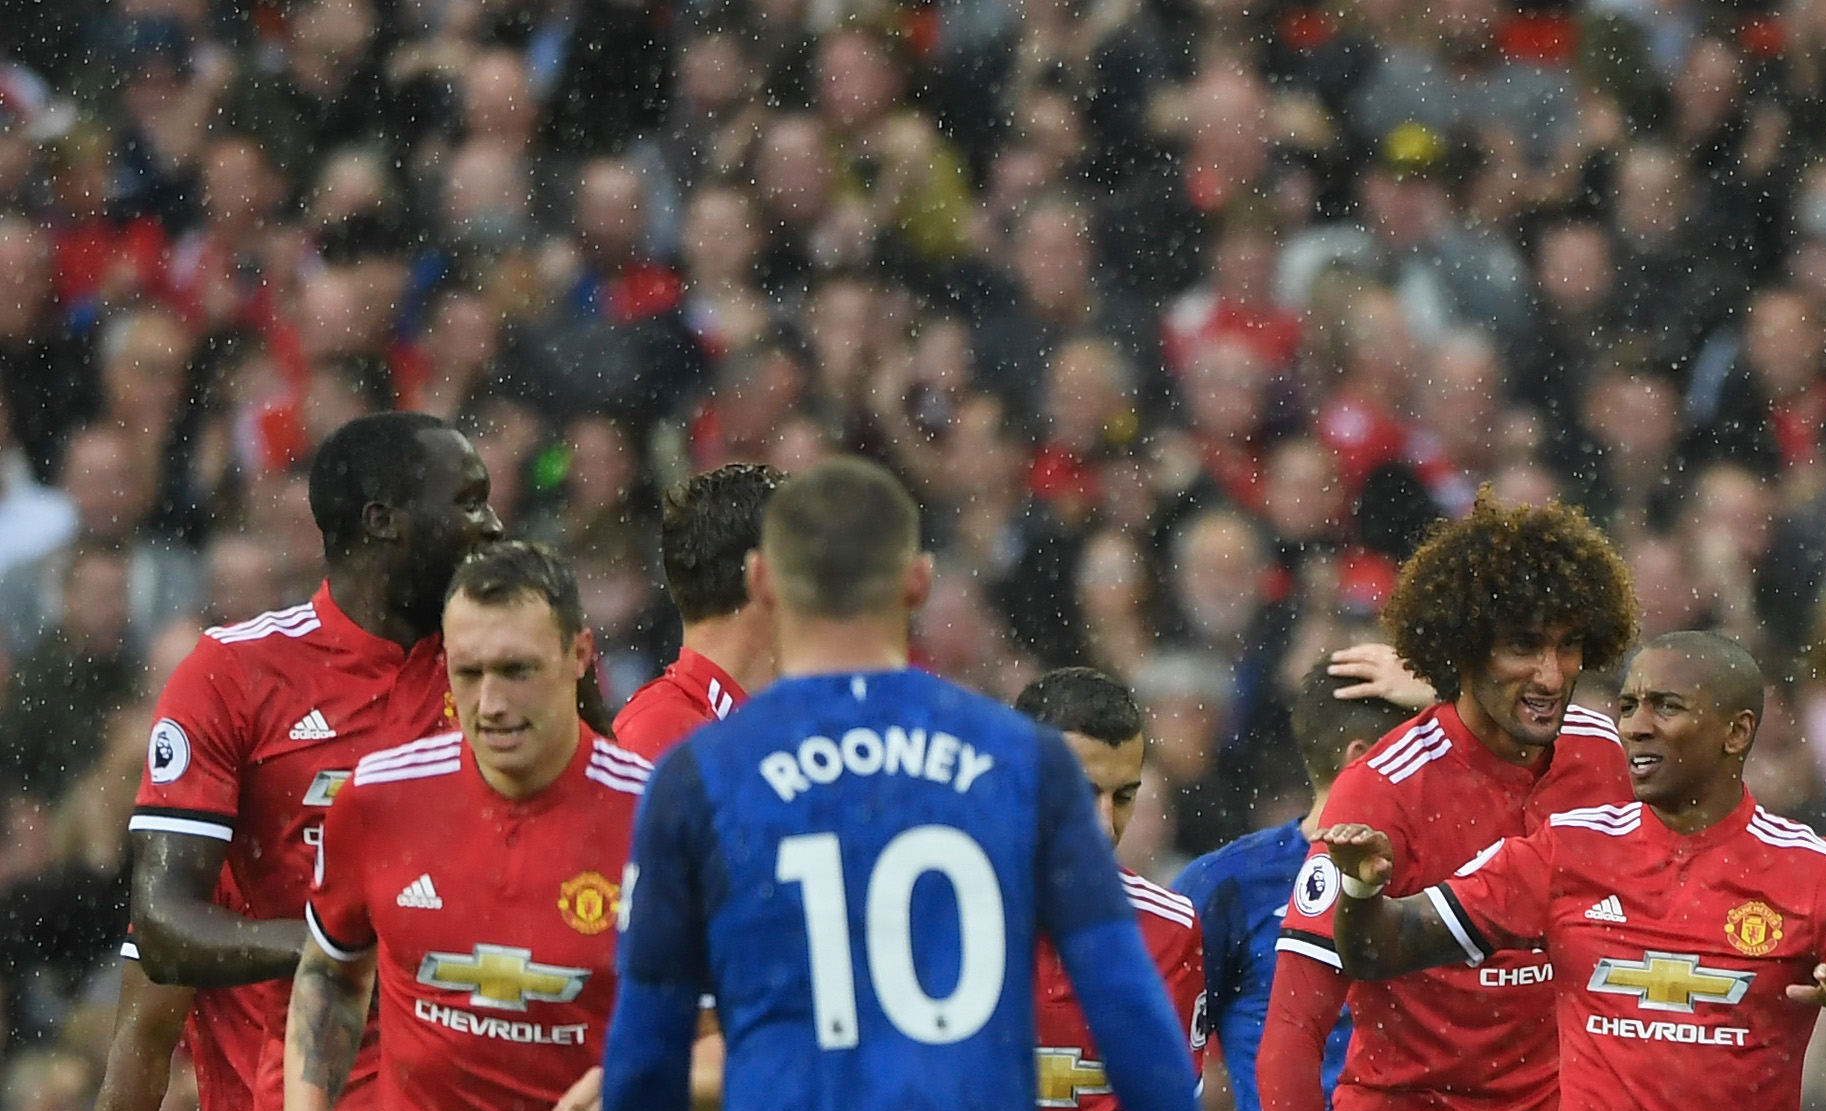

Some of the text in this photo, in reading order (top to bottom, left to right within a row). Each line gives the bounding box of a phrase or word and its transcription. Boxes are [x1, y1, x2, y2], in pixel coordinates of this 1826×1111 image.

[759, 725, 995, 803] ROONEY
[775, 823, 1006, 1050] 10
[1584, 909, 1627, 923] adidas
[415, 998, 588, 1045] CHEVROLET
[1586, 1015, 1749, 1046] CHEVROLET
